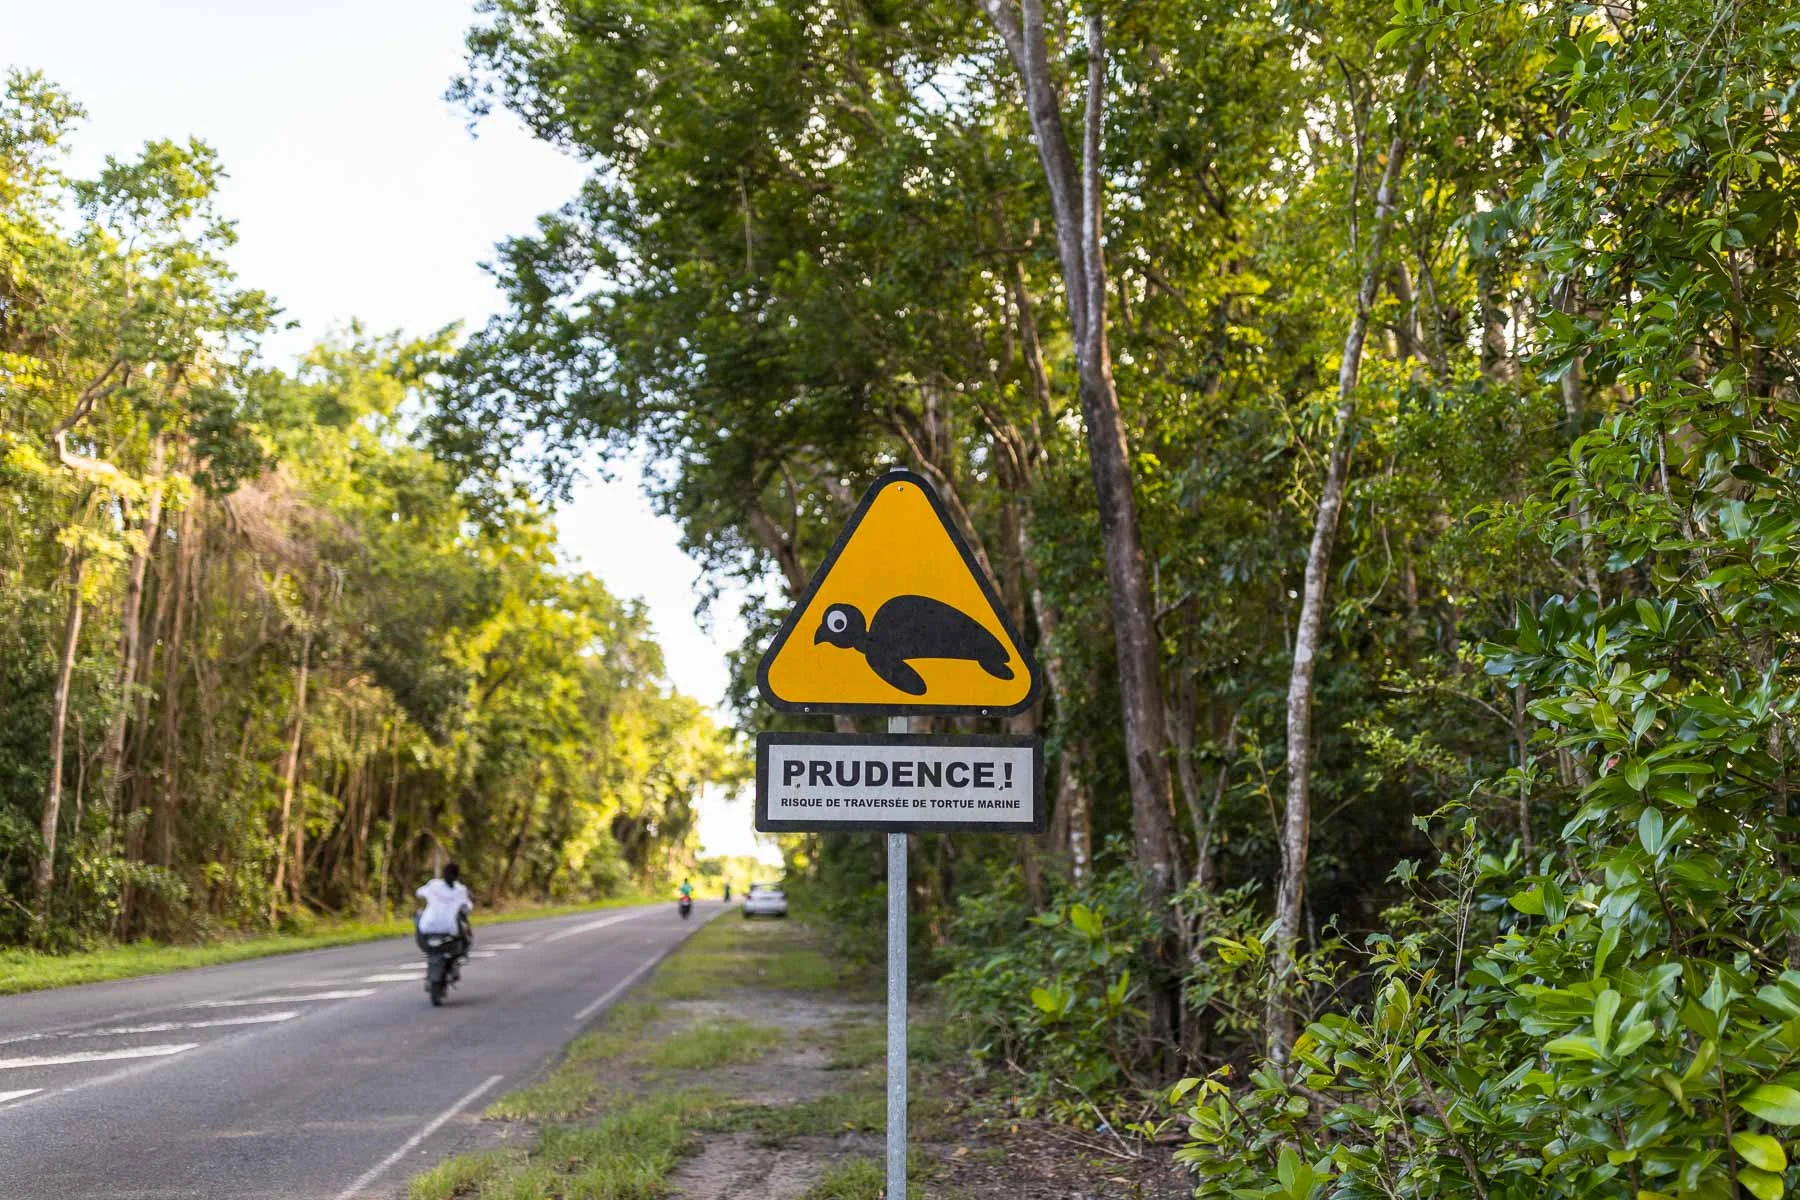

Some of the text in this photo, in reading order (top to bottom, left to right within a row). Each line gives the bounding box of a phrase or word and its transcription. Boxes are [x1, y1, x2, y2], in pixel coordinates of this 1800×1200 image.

[781, 798, 822, 807] RISQUE
[844, 797, 909, 808] TRAVERSÉE
[913, 800, 926, 808] DE
[930, 799, 974, 808] TORTUE
[978, 800, 1020, 808] MARINE
